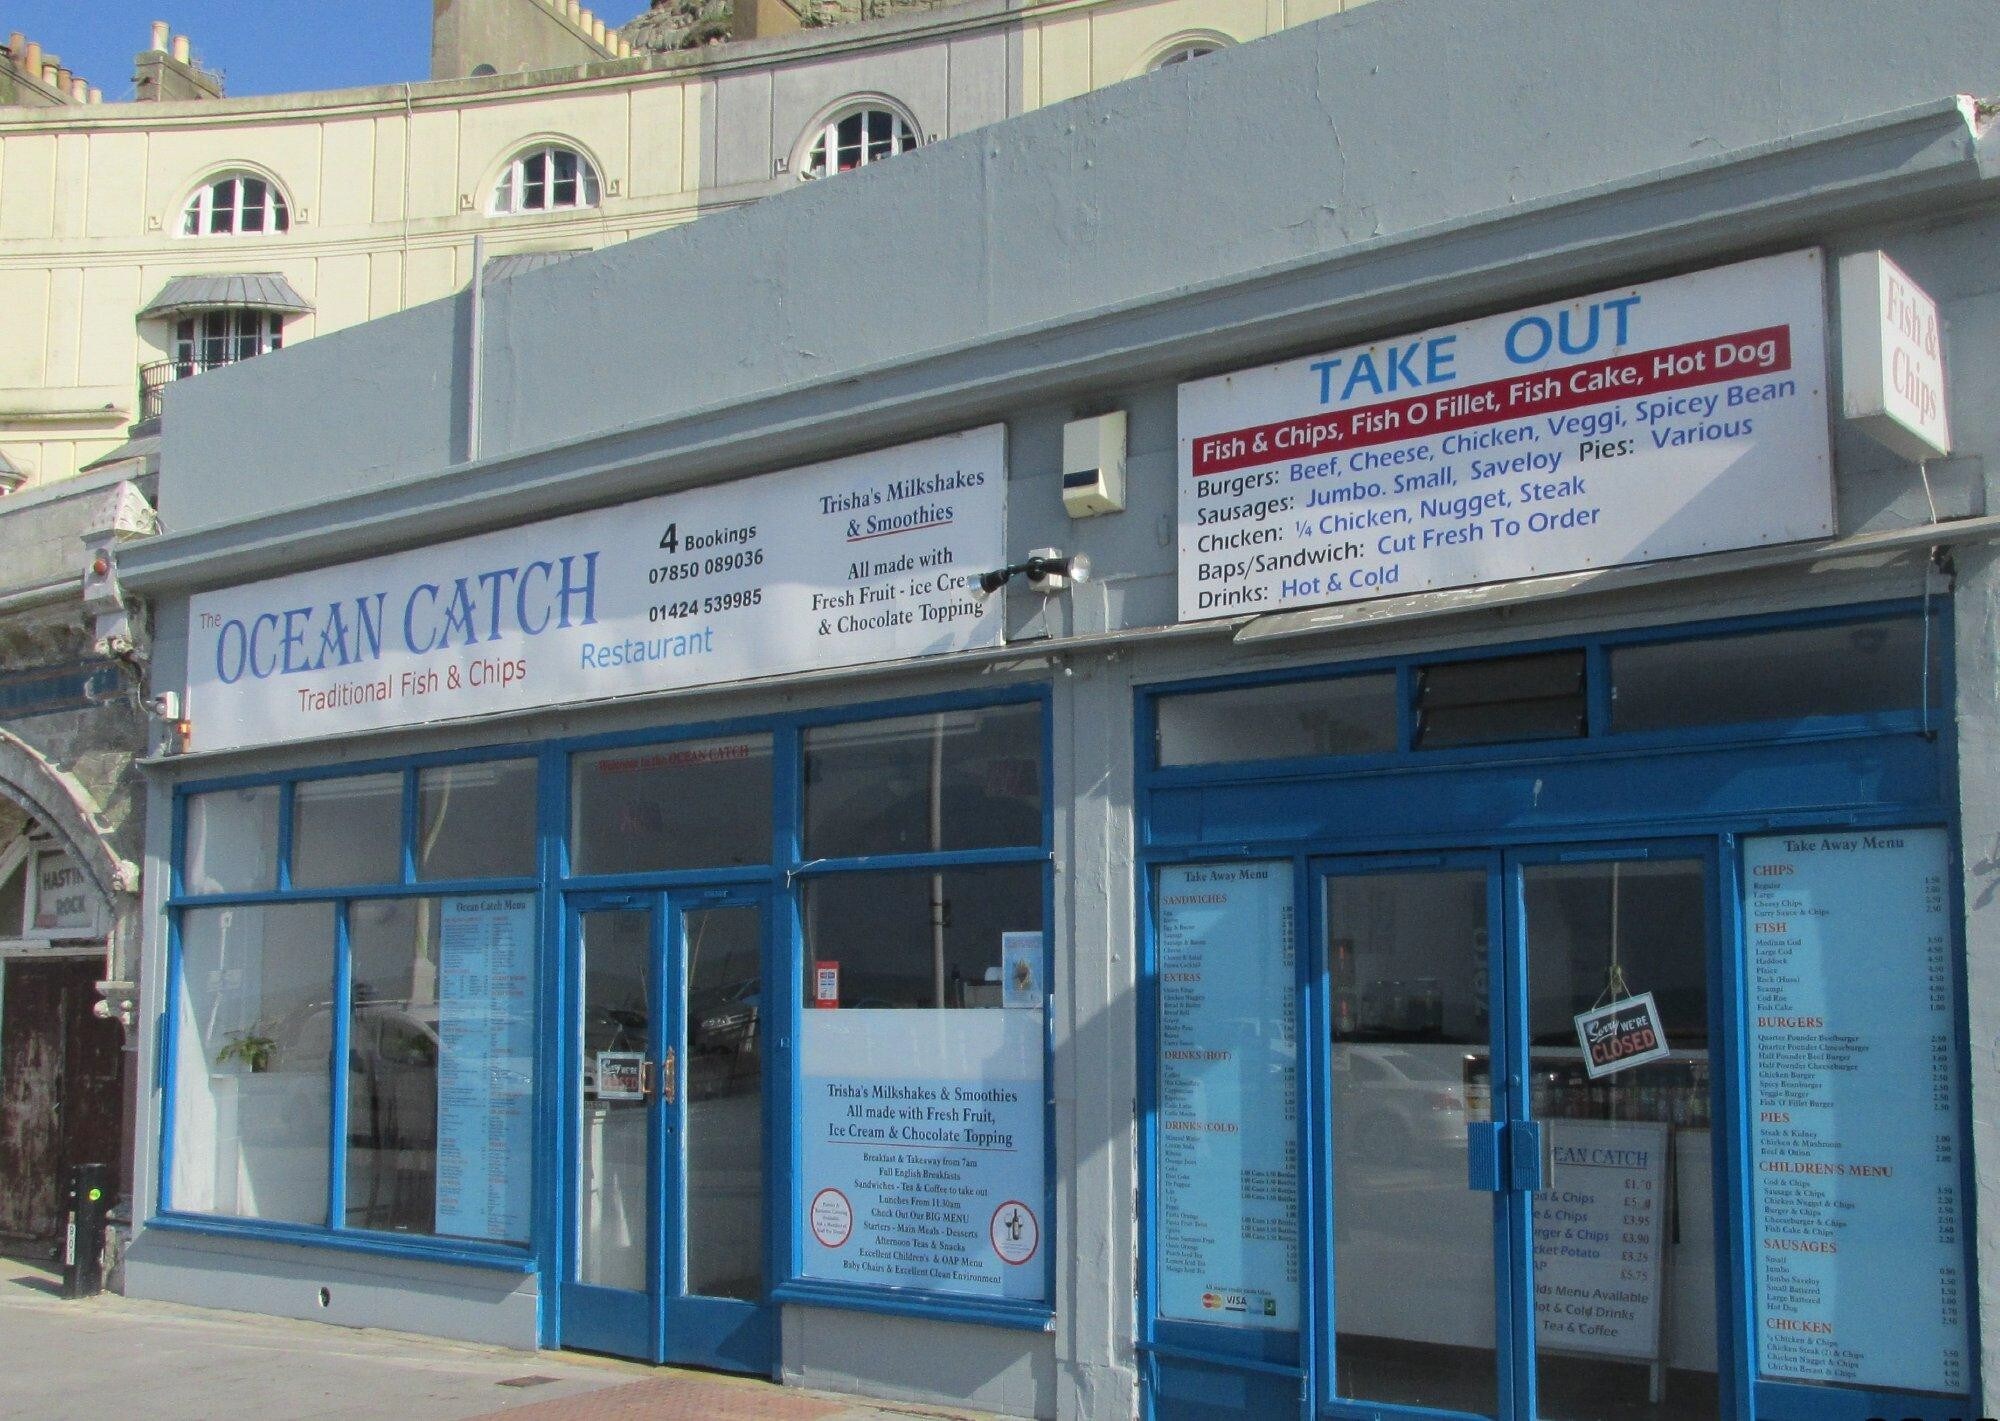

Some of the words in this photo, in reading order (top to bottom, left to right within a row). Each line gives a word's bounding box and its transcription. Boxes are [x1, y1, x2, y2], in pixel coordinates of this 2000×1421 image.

[1886, 276, 1921, 347] Fish
[1925, 315, 1937, 360] &
[1310, 335, 1456, 405] TAKE
[1504, 295, 1641, 365] OUT
[1892, 346, 1936, 425] Chips
[1202, 437, 1245, 463] Fish
[1252, 432, 1268, 453] &
[1275, 422, 1344, 449] Chips,
[1352, 409, 1400, 435] Fish
[1406, 403, 1428, 425] O
[1436, 390, 1501, 421] Fillet,
[1509, 378, 1561, 406] Fish
[1569, 365, 1644, 395] Cake,
[1653, 351, 1706, 380] Hot
[1715, 340, 1776, 369] Dog
[1198, 470, 1279, 499] Burgers:
[1290, 456, 1342, 482] Beef,
[1350, 444, 1434, 473] Cheese,
[1442, 423, 1540, 456] Chicken,
[1548, 405, 1627, 438] Veggi,
[1636, 392, 1718, 423] Spicey
[1727, 379, 1795, 408] Bean
[1198, 496, 1294, 526] Sausages:
[1306, 482, 1386, 508] Jumbo.
[1394, 466, 1457, 494] Small,
[1471, 451, 1562, 480] Saveloy
[1580, 439, 1634, 461] Pies:
[1652, 417, 1753, 449] Various
[820, 488, 882, 514] Trisha's
[886, 470, 985, 502] Milkshakes
[846, 519, 860, 538] &
[866, 504, 954, 534] Smoothies
[1198, 525, 1283, 553] Chicken:
[1320, 506, 1412, 535] Chicken,
[1420, 488, 1511, 519] Nugget,
[1520, 475, 1586, 503] Steak
[659, 523, 679, 554] 4
[685, 526, 757, 551] Bookings
[1198, 541, 1365, 582] Baps/Sandwich:
[1378, 533, 1416, 555] Cut
[1423, 523, 1483, 549] Fresh
[1491, 518, 1520, 538] To
[1528, 507, 1600, 533] Order
[649, 562, 699, 585] 07850
[704, 549, 764, 576] 089036
[848, 561, 869, 580] All
[874, 555, 914, 576] made
[919, 547, 954, 568] with
[812, 590, 854, 611] Fresh
[859, 584, 896, 605] Fruit
[910, 579, 932, 597] ice
[1199, 585, 1269, 609] Drinks:
[1281, 578, 1320, 598] Hot
[1327, 573, 1341, 592] &
[1350, 564, 1399, 588] Cold
[649, 600, 699, 623] 01424
[704, 588, 763, 615] 539985
[200, 613, 222, 631] The
[217, 592, 388, 685] OCEAN
[404, 550, 601, 656] CATCH
[819, 619, 832, 636] &
[837, 610, 914, 634] Chocolate
[918, 597, 984, 623] Topping
[580, 625, 715, 672] Restaurant
[298, 676, 393, 713] Traditional
[401, 669, 439, 698] Fish
[446, 665, 461, 690] &
[469, 656, 527, 688] Chips
[1785, 840, 1816, 852] Take
[1821, 839, 1857, 852] Away
[1863, 837, 1905, 849] Menu
[1184, 872, 1206, 882] Take
[1211, 870, 1237, 882] Away
[1240, 870, 1268, 880] Menu
[1753, 864, 1794, 876] CHIPS
[1755, 922, 1787, 933] FISH
[1164, 973, 1201, 982] EXTRAS
[1585, 1020, 1619, 1043] Sorry
[1620, 1015, 1649, 1031] WE'RE
[1758, 1017, 1824, 1027] BURGERS
[1592, 1029, 1655, 1062] CLOSED
[827, 1084, 868, 1098] Trisha's
[872, 1085, 936, 1101] Milkshakes
[941, 1086, 950, 1100] &
[955, 1087, 1018, 1102] Smoothies
[847, 1105, 862, 1117] All
[866, 1106, 895, 1119] made
[899, 1107, 923, 1120] with
[927, 1107, 959, 1121] Fresh
[963, 1108, 996, 1125] Fruit,
[1760, 1112, 1790, 1123] PIES
[829, 1122, 845, 1137] Ice
[849, 1124, 885, 1138] Cream
[889, 1125, 898, 1139] &
[902, 1126, 960, 1142] Chocolate
[964, 1129, 1012, 1147] Topping
[1165, 1121, 1201, 1130] DRINKS
[1204, 1121, 1239, 1132] (COLD)
[863, 1152, 895, 1162] Breakfast
[907, 1155, 940, 1166] Takeaway
[943, 1156, 960, 1166] from
[962, 1158, 977, 1167] 7am
[1593, 1150, 1648, 1167] CATCH
[879, 1167, 893, 1176] Full
[895, 1167, 920, 1179] English
[923, 1169, 960, 1180] Breakfasts
[1759, 1161, 1845, 1176] CHILDREN'S
[1848, 1165, 1894, 1178] MENU
[854, 1179, 895, 1190] Sandwiches
[902, 1182, 913, 1191] Tea
[924, 1183, 947, 1194] Coffee
[958, 1185, 973, 1195] take
[975, 1187, 988, 1196] out
[879, 1194, 909, 1204] Lunches
[911, 1196, 930, 1206] From
[871, 1207, 892, 1218] Check
[926, 1211, 940, 1221] BIG
[944, 1213, 969, 1224] MENU
[863, 1220, 891, 1231] Starters
[897, 1223, 916, 1234] Main
[918, 1225, 940, 1235] Meals
[946, 1227, 978, 1239] Desserts
[875, 1236, 911, 1247] Afternoon
[913, 1238, 929, 1249] Teas
[939, 1241, 966, 1251] Snacks
[1764, 1239, 1837, 1253] SAUSAGES
[859, 1248, 892, 1259] Excellent
[893, 1251, 929, 1262] Children's
[942, 1255, 959, 1266] OAP
[961, 1257, 983, 1268] Menu
[843, 1260, 861, 1271] Baby
[861, 1261, 884, 1273] Chairs
[895, 1265, 928, 1276] Excellent
[930, 1268, 951, 1279] Clean
[953, 1271, 1001, 1284] Environment
[1226, 1296, 1248, 1306] VISA
[1556, 1286, 1589, 1299] Menu
[1593, 1288, 1649, 1304] Available
[1596, 1307, 1635, 1321] Drinks
[1544, 1320, 1564, 1332] Tea
[1578, 1322, 1618, 1337] Coffee
[1766, 1318, 1832, 1334] CHICKEN
